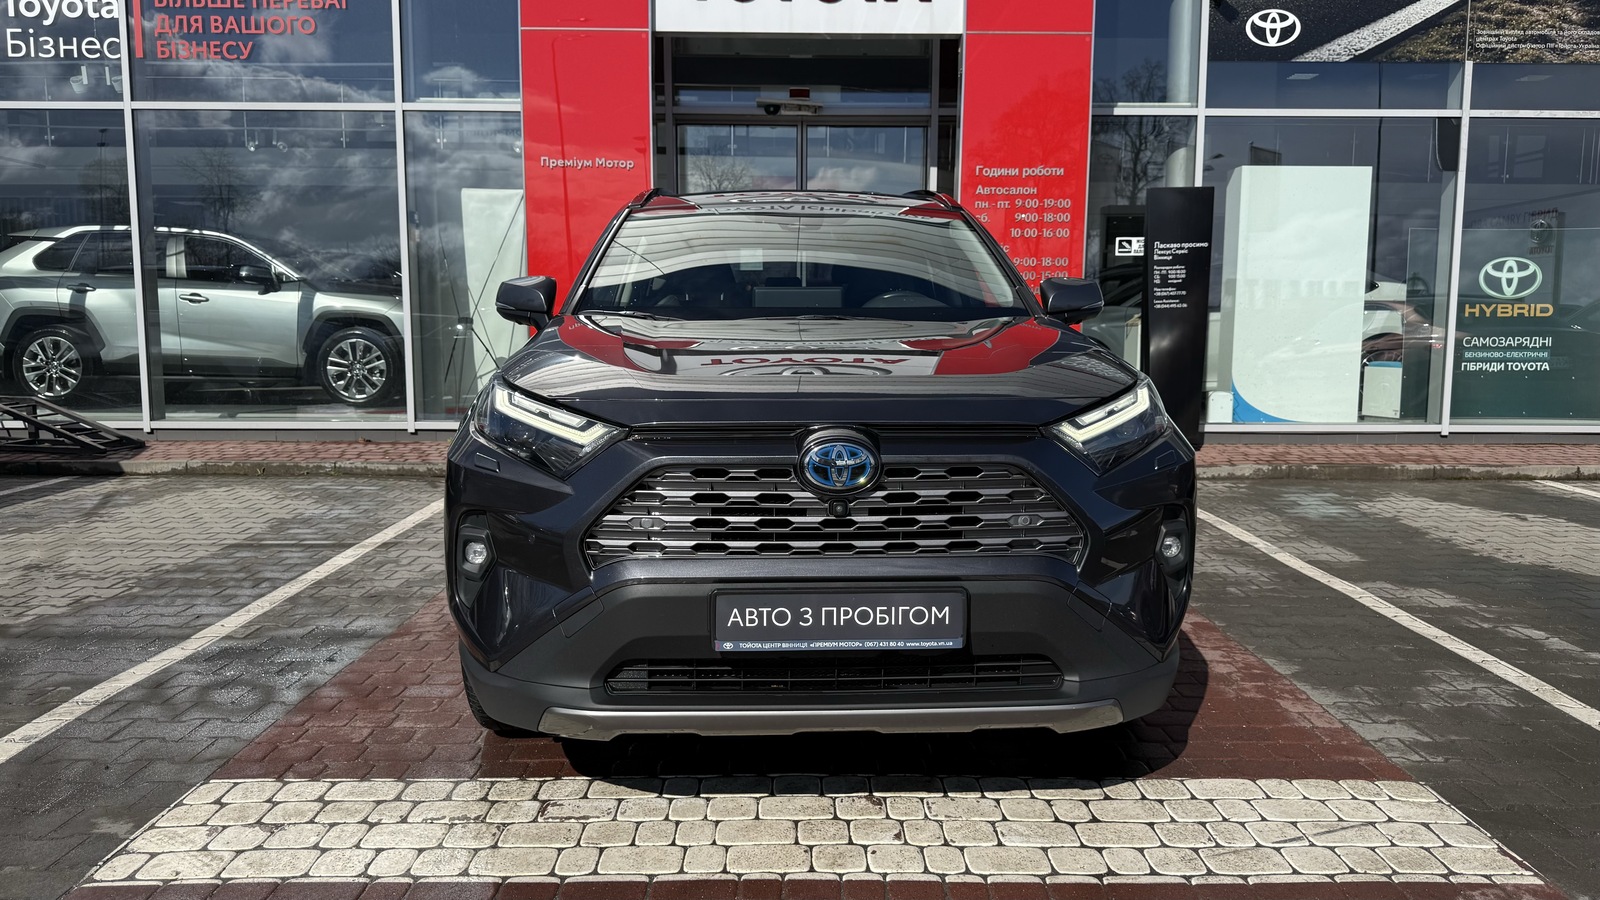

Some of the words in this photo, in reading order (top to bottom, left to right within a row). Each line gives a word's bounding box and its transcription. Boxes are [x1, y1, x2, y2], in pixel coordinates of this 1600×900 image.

[154, 15, 202, 36] ДЛЯ
[210, 16, 316, 34] ВАШОГО
[6, 28, 120, 58] Бізнес
[156, 41, 253, 60] БІЗНЕСУ
[541, 156, 592, 168] Преміум
[596, 158, 634, 170] Мотор
[975, 166, 1018, 177] Години
[1022, 165, 1064, 178] роботи
[976, 185, 1037, 194] Автосалон
[1015, 199, 1071, 209] 9:00-19:00
[1015, 213, 1070, 222] 9:00-18:00
[1010, 228, 1070, 238] 10:00-16:00
[1013, 257, 1069, 267] 9:00-18:00
[1464, 304, 1553, 317] HYBRID
[1463, 337, 1552, 348] САМОЗАРЯДНІ
[1461, 362, 1504, 372] ГІБРИДИ
[1506, 362, 1550, 371] TOYOTA
[728, 607, 792, 627] АВТО
[821, 606, 950, 626] ПРОБІГОМ
